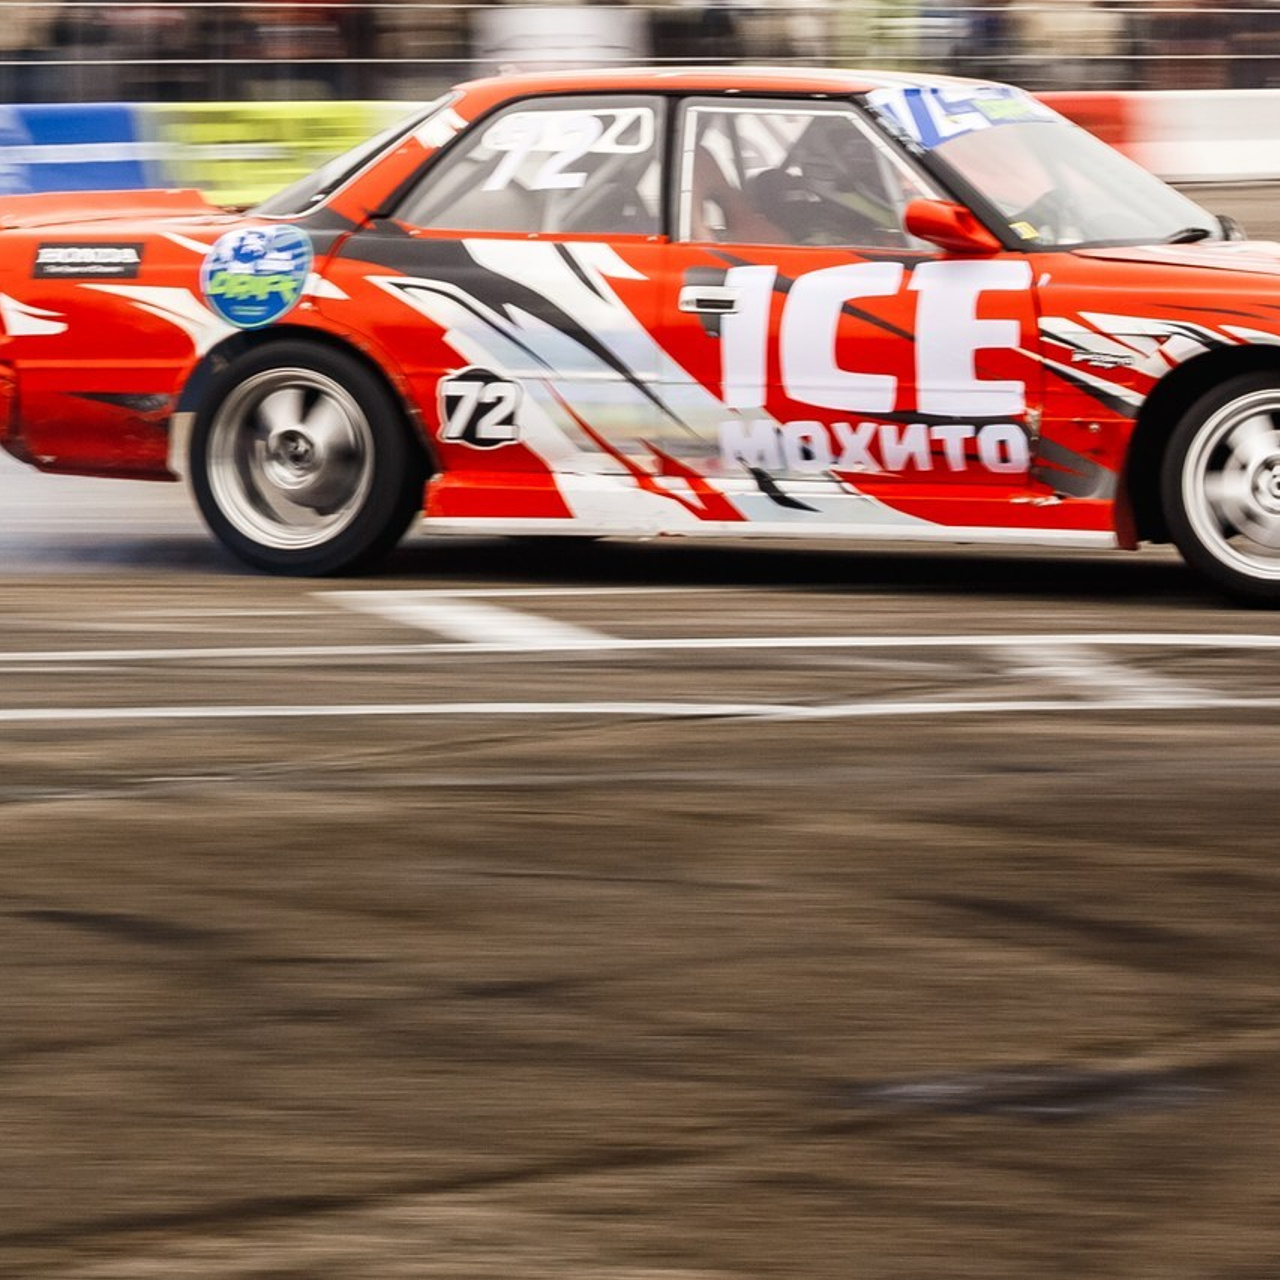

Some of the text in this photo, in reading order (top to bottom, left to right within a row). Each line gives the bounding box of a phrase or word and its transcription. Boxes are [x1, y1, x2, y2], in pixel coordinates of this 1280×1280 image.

[720, 260, 1033, 416] ICE
[442, 381, 518, 439] 72
[720, 420, 1031, 473] МОХИТО
